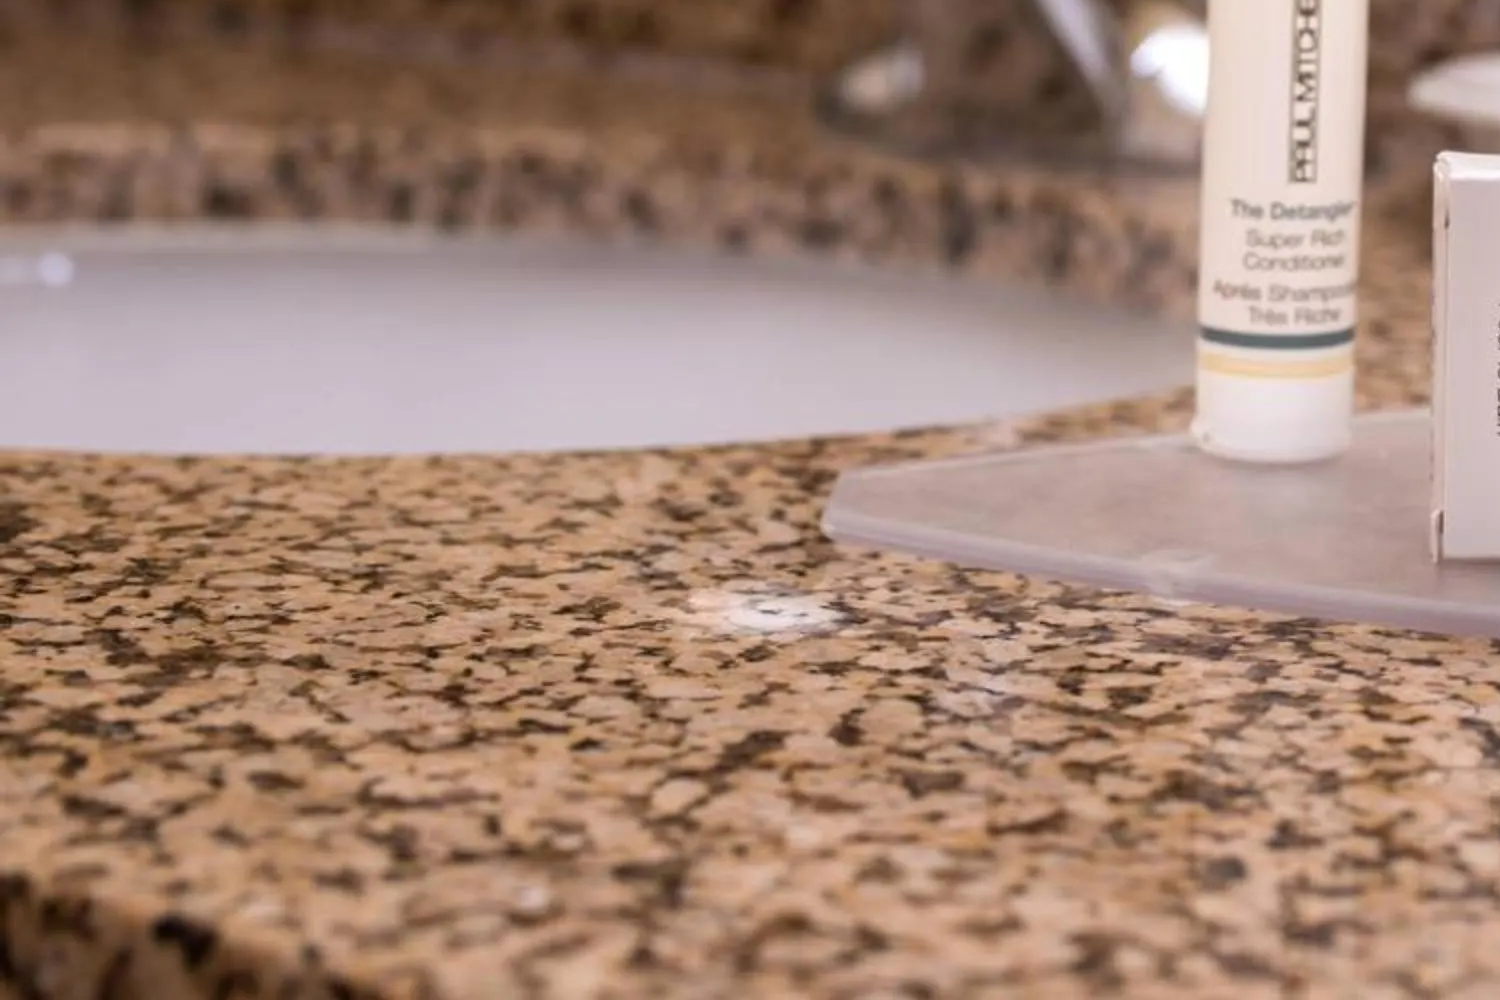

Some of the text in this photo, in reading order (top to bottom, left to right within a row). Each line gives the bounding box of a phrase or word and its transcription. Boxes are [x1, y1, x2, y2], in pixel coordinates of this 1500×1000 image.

[1293, 106, 1317, 183] PAUL
[1231, 199, 1264, 218] The
[1245, 229, 1304, 248] Super
